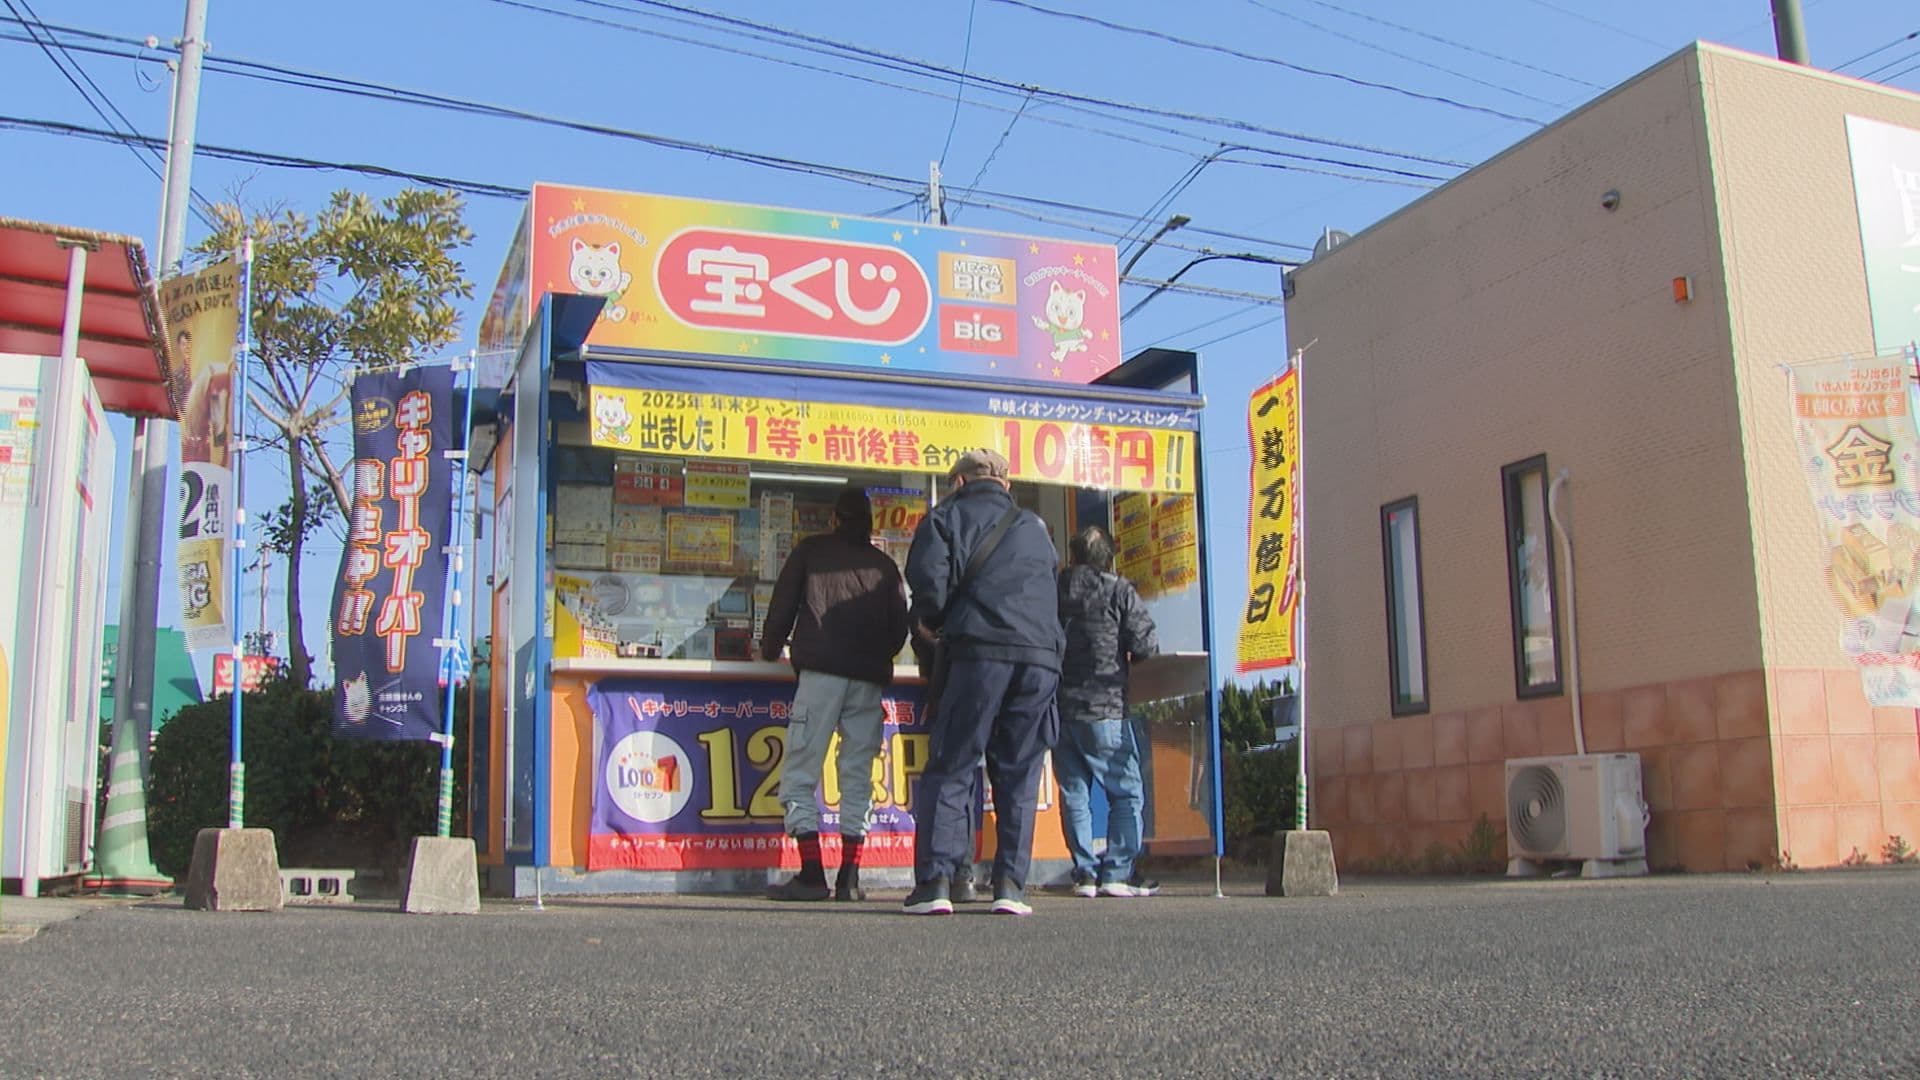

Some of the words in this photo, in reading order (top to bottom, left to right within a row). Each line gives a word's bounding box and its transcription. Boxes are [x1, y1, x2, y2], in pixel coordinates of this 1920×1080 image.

[687, 246, 900, 326] 宝くじ
[953, 260, 1003, 278] MEGA
[642, 391, 704, 410] 2025年
[987, 397, 1194, 427] 早岐イオンタウンチャンスセンター
[374, 390, 433, 673] キャリーオーバー
[656, 754, 680, 794] 7
